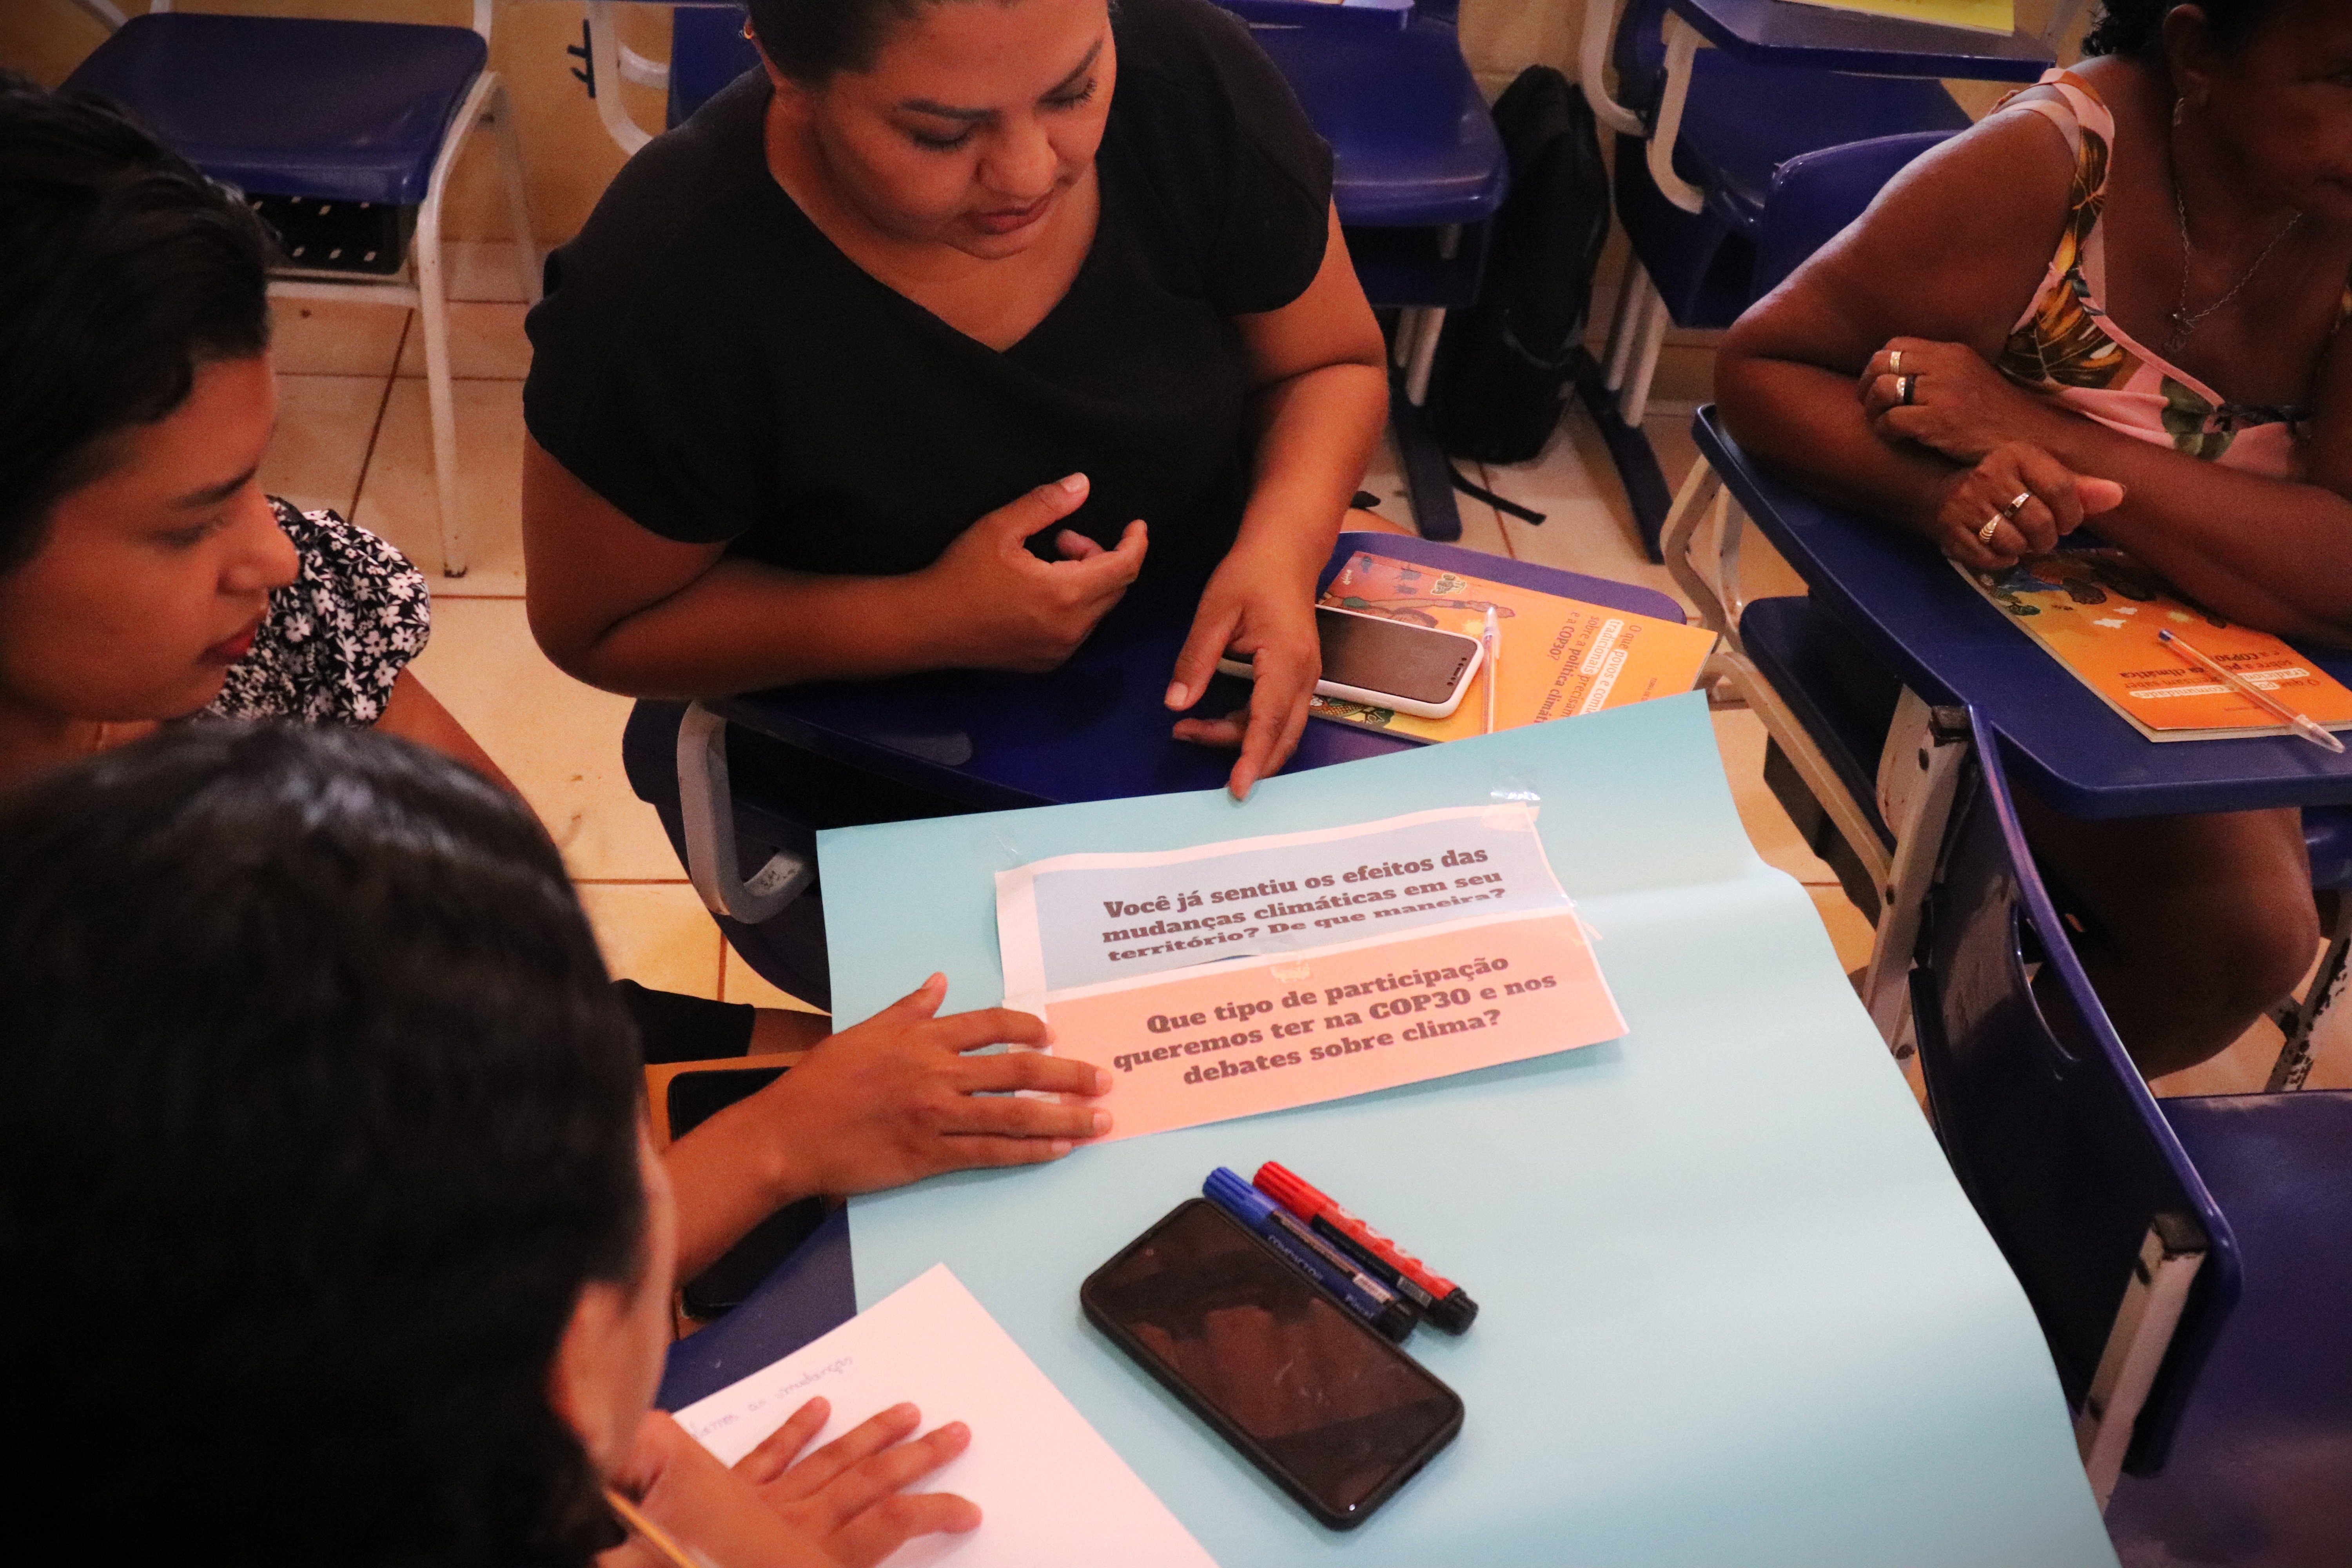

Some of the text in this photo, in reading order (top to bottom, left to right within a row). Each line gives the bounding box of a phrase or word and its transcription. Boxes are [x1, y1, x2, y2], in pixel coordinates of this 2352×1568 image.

[1547, 626, 1575, 661] COP30?
[1580, 616, 1599, 639] sobre
[1585, 621, 1621, 673] tradicionais
[1619, 633, 1634, 649] que
[1604, 650, 1625, 679] povos
[2119, 668, 2186, 679] climática
[1587, 688, 1606, 713] comu
[2134, 686, 2224, 697] comunidades
[1103, 849, 1488, 918] Você já sentiu os efeitos das
[1102, 873, 1502, 943] mudanças climáticas em seu
[1108, 888, 1505, 961] território? De que maneira?
[1147, 958, 1508, 1033] Que tipo de participação
[1114, 976, 1556, 1072] queremos ter na COP30 e nos
[1183, 1009, 1500, 1085] debates sobre clima?
